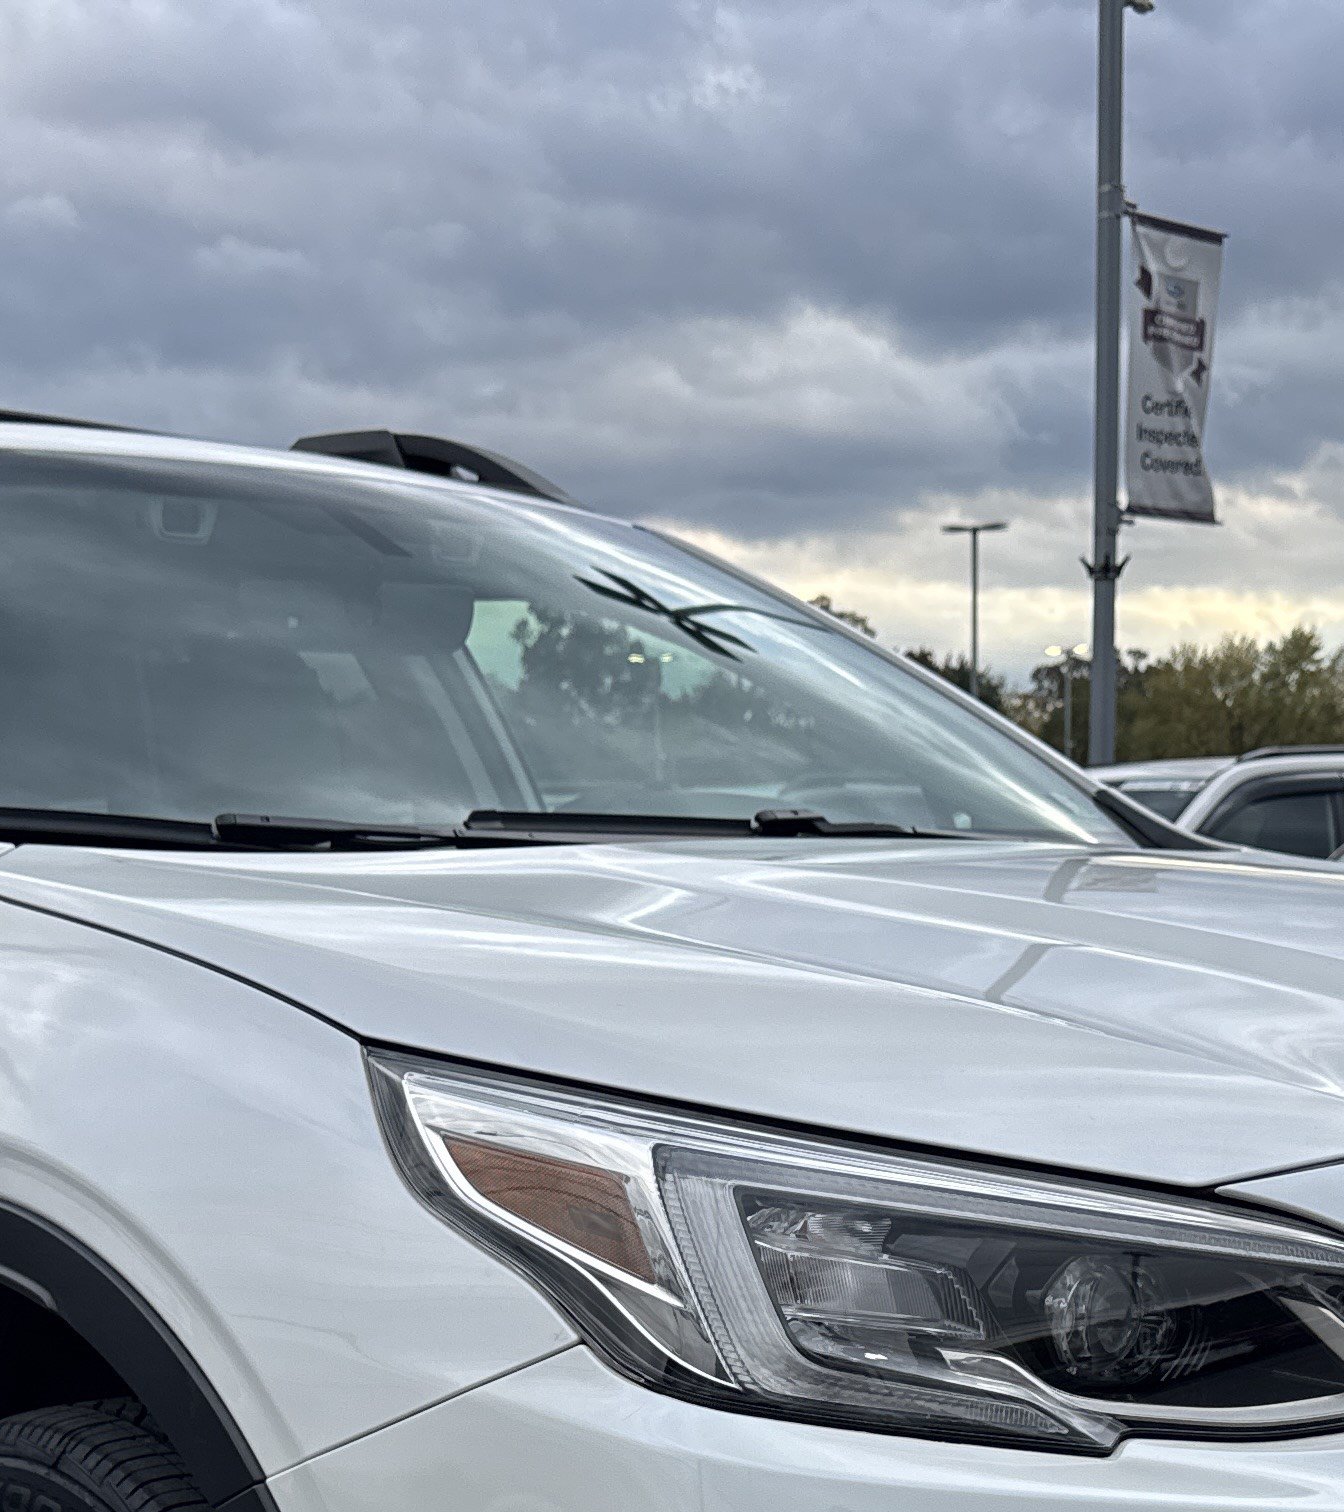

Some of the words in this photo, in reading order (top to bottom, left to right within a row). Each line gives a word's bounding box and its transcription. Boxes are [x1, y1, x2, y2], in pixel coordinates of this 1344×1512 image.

[1141, 392, 1191, 418] Certifi
[1136, 421, 1200, 449] Inspecte
[1140, 449, 1203, 477] Covered
